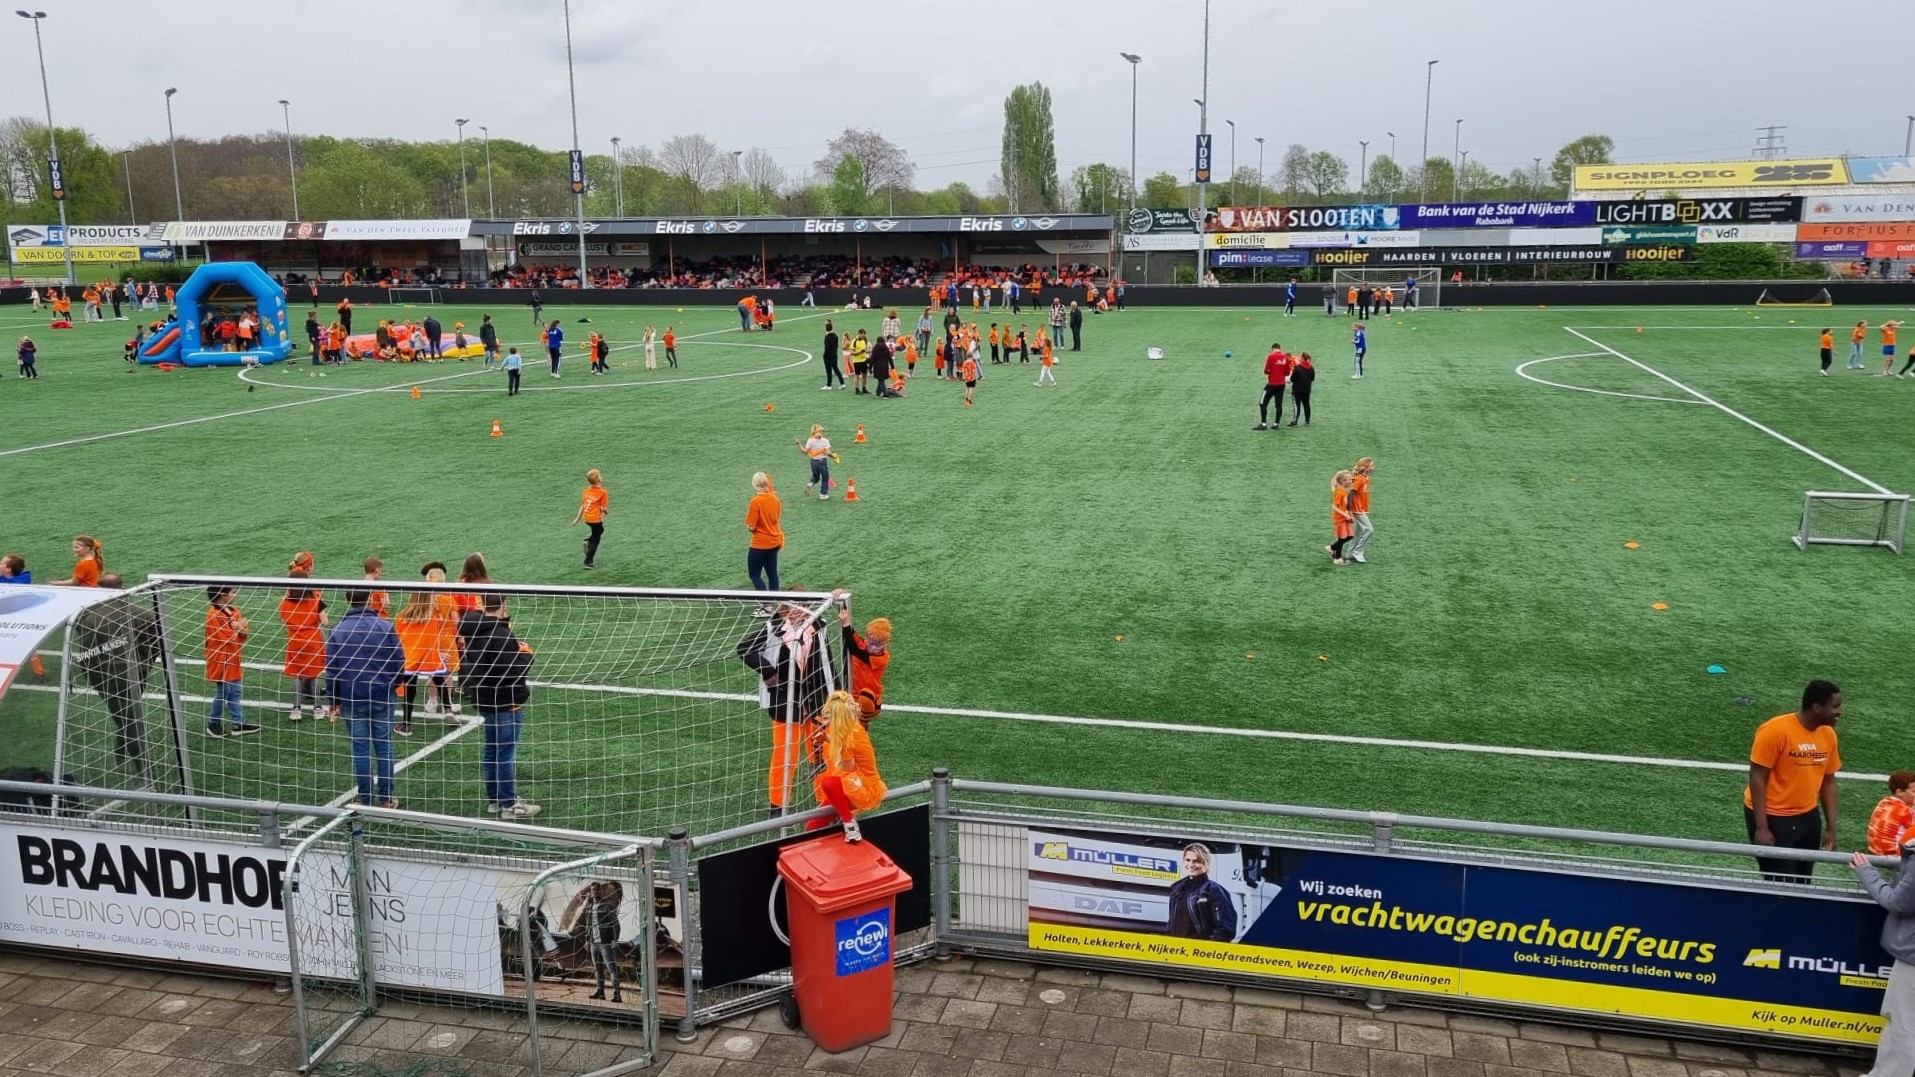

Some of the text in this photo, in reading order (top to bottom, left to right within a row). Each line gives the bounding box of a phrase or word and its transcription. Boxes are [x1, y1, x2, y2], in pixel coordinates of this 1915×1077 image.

[1199, 136, 1208, 169] VDB
[572, 152, 580, 182] VDB
[50, 162, 61, 189] VDB
[1590, 170, 1736, 180] SIGNPLOEG
[1418, 203, 1575, 217] Bank van de Stad Nijkerk
[1844, 204, 1914, 212] VAN DEN
[960, 217, 1002, 232] Ekris
[1240, 208, 1374, 227] VAN SLOOTEN
[1476, 217, 1514, 226] Rabobank
[70, 228, 140, 238] PRODUCTS
[185, 226, 206, 237] VAN
[208, 225, 274, 237] DUINKERKEN
[512, 222, 550, 234] Ekris
[656, 220, 695, 234] Ekris
[804, 219, 845, 232] Ekris
[1216, 235, 1266, 245] domicilie
[23, 250, 48, 260] VAN
[88, 250, 94, 258] &
[98, 249, 116, 258] TOP
[532, 244, 604, 252] GRAND CAF LUST
[1626, 246, 1685, 261] Hooijer
[1823, 244, 1844, 252] aaff
[1316, 250, 1370, 264] Hooijer
[1384, 251, 1612, 261] HAARDEN VLOEREN INTERIEURBOUW
[0, 622, 48, 631] OLUTIONS
[17, 835, 299, 911] BRANDHOF
[331, 865, 391, 893] MN
[1300, 880, 1382, 900] Wij zoeken
[323, 893, 406, 922] JENS
[1074, 896, 1142, 914] DAF
[25, 894, 410, 956] KLEDING VOOR ECHTE MANEN!
[1298, 901, 1716, 964] vrachtwagenchauffeurs
[838, 924, 888, 952] renewi
[4, 922, 24, 932] BOSS
[30, 925, 59, 935] REPLAY
[112, 934, 157, 946] CAVALLARO
[164, 940, 190, 950] REHAB
[196, 944, 240, 956] VANGUARD
[248, 950, 264, 959] ROY
[266, 952, 290, 962] ROBS
[374, 964, 424, 977] LACKSTONE
[440, 970, 464, 980] MEER
[1044, 933, 1452, 986] Holten, Lekkerkerk, Nijkerk, Roelofarendsveen, Wezep, Wijchen/Beuningen
[1514, 951, 1717, 985] (ook zij-instromers leiden we op)
[1788, 956, 1894, 979] MÜLLE
[1752, 1010, 1883, 1034] Kijk op Muller.nl/va
